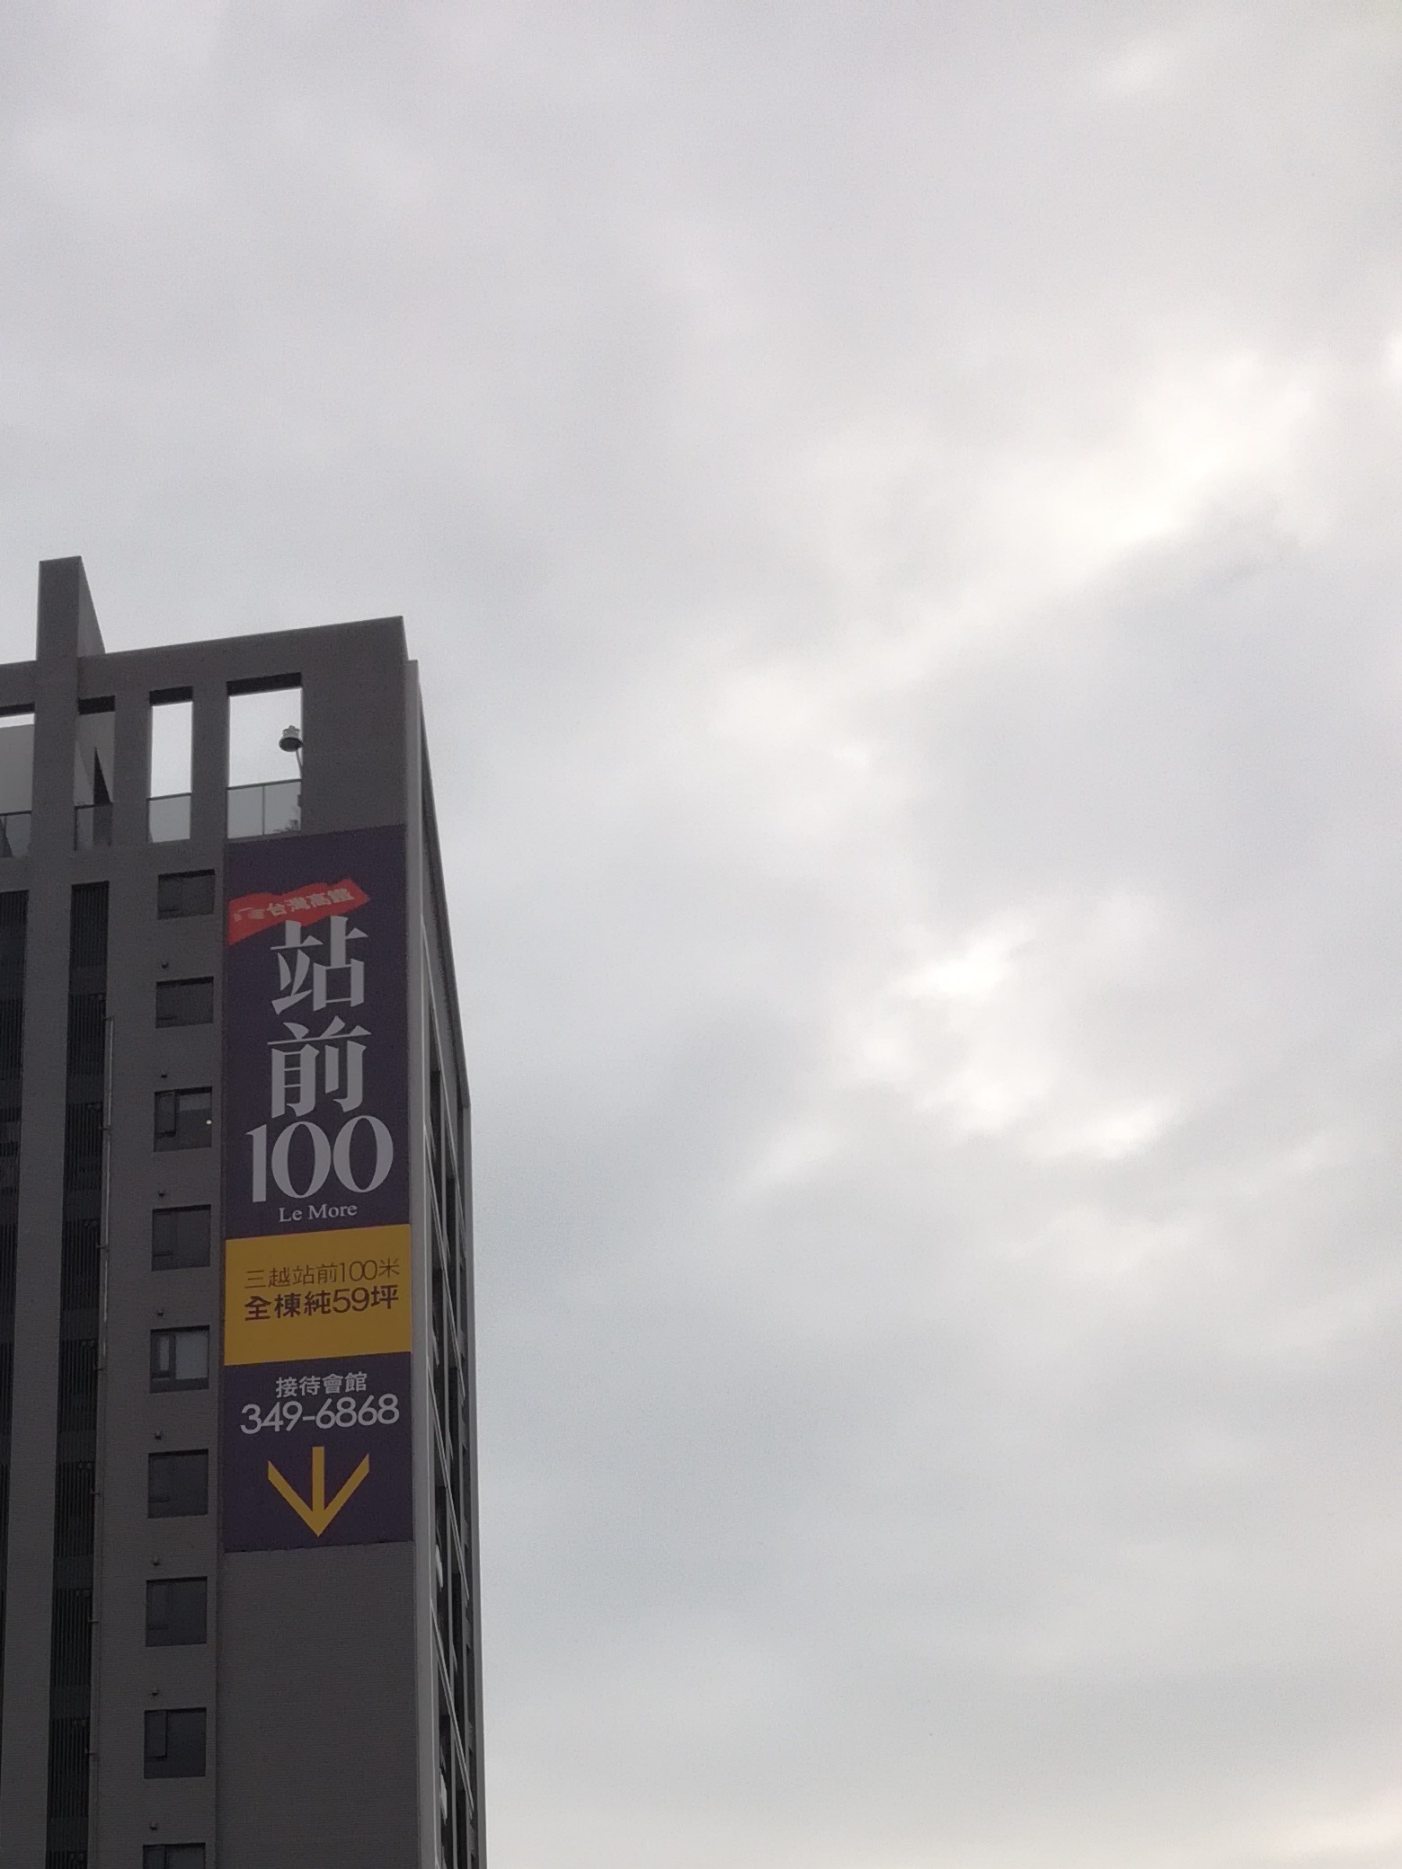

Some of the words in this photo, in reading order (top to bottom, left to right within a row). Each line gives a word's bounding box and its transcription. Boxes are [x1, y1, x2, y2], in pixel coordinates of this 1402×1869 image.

[278, 1207, 303, 1223] Le
[308, 1203, 359, 1220] More
[243, 1257, 401, 1290] 三越站前100米
[243, 1284, 400, 1322] 全棟純59坪
[275, 1371, 368, 1399] 接待會館
[239, 1393, 401, 1435] 349-6868
